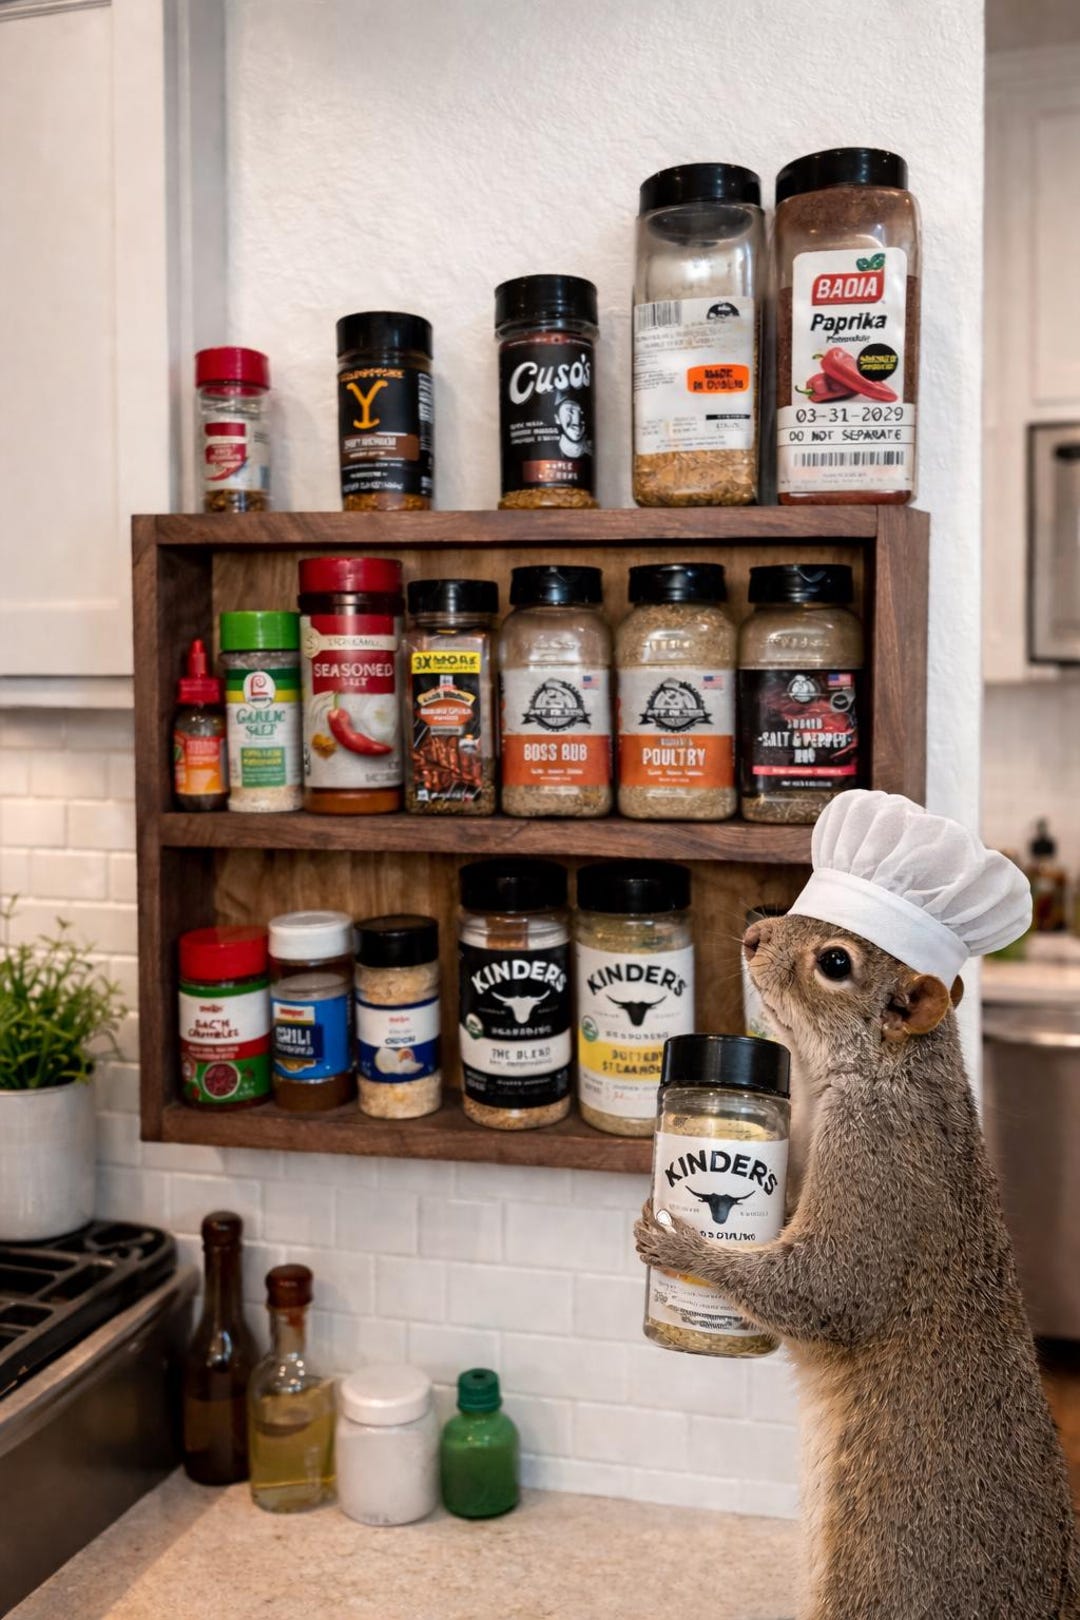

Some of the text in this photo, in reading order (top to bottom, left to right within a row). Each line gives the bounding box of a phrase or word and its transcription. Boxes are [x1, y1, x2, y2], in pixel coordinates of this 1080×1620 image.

[815, 276, 878, 300] BADIA
[810, 311, 888, 336] Paprika
[509, 353, 590, 405] Cuso's
[795, 406, 904, 424] 03-31-2029
[789, 431, 804, 442] DO
[811, 430, 835, 442] NOT
[314, 663, 394, 678] SEASONED
[415, 656, 432, 670] 3X
[524, 743, 558, 762] BOSS
[642, 747, 706, 767] POULTRY
[586, 963, 688, 998] KINDER'S
[664, 1149, 779, 1196] KINDER'S
